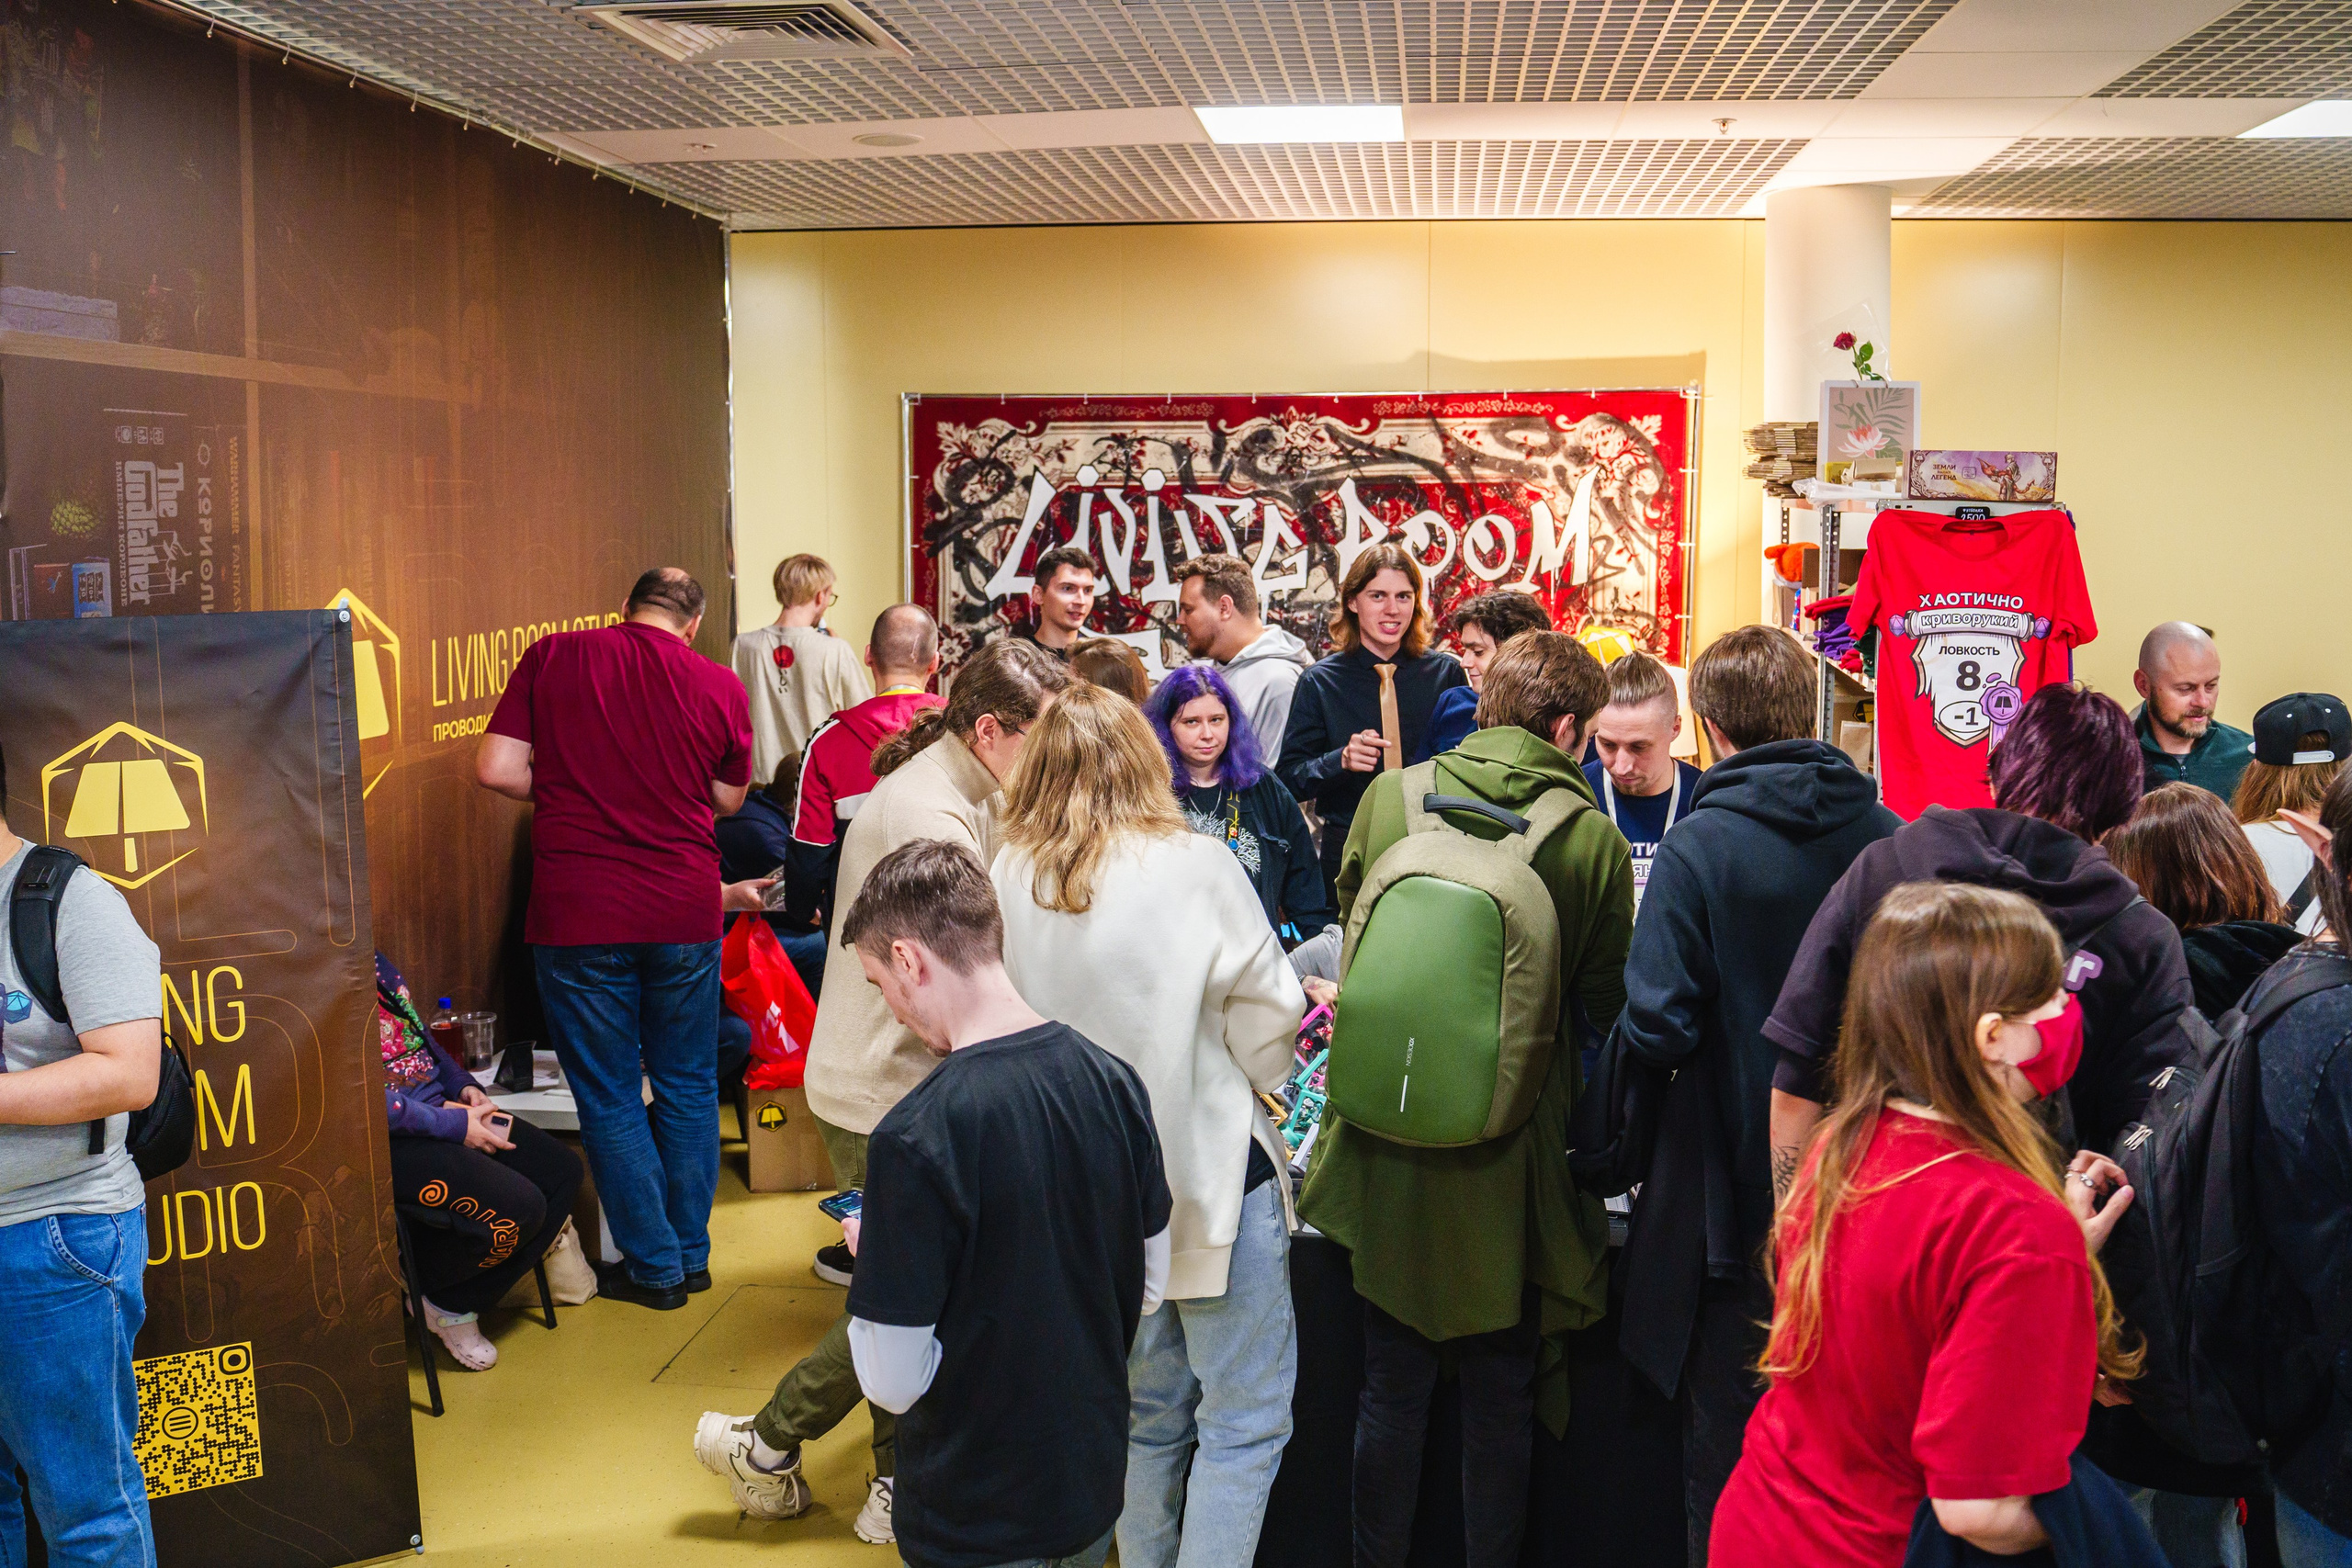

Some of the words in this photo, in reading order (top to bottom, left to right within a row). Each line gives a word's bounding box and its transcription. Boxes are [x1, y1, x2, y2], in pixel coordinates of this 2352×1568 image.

[157, 461, 185, 517] The
[124, 460, 159, 606] Godfather
[1334, 464, 1601, 593] ROOM
[1918, 592, 2024, 609] ХАОТИЧНО
[1921, 613, 2019, 629] криворукий
[1939, 646, 2000, 656] ЛОВКОСТЬ
[432, 629, 508, 707] LIVING
[1956, 660, 1981, 692] 8
[433, 712, 493, 742] ПРОВОДИ
[1954, 706, 1979, 726] -1
[147, 1181, 266, 1266] UDIO
